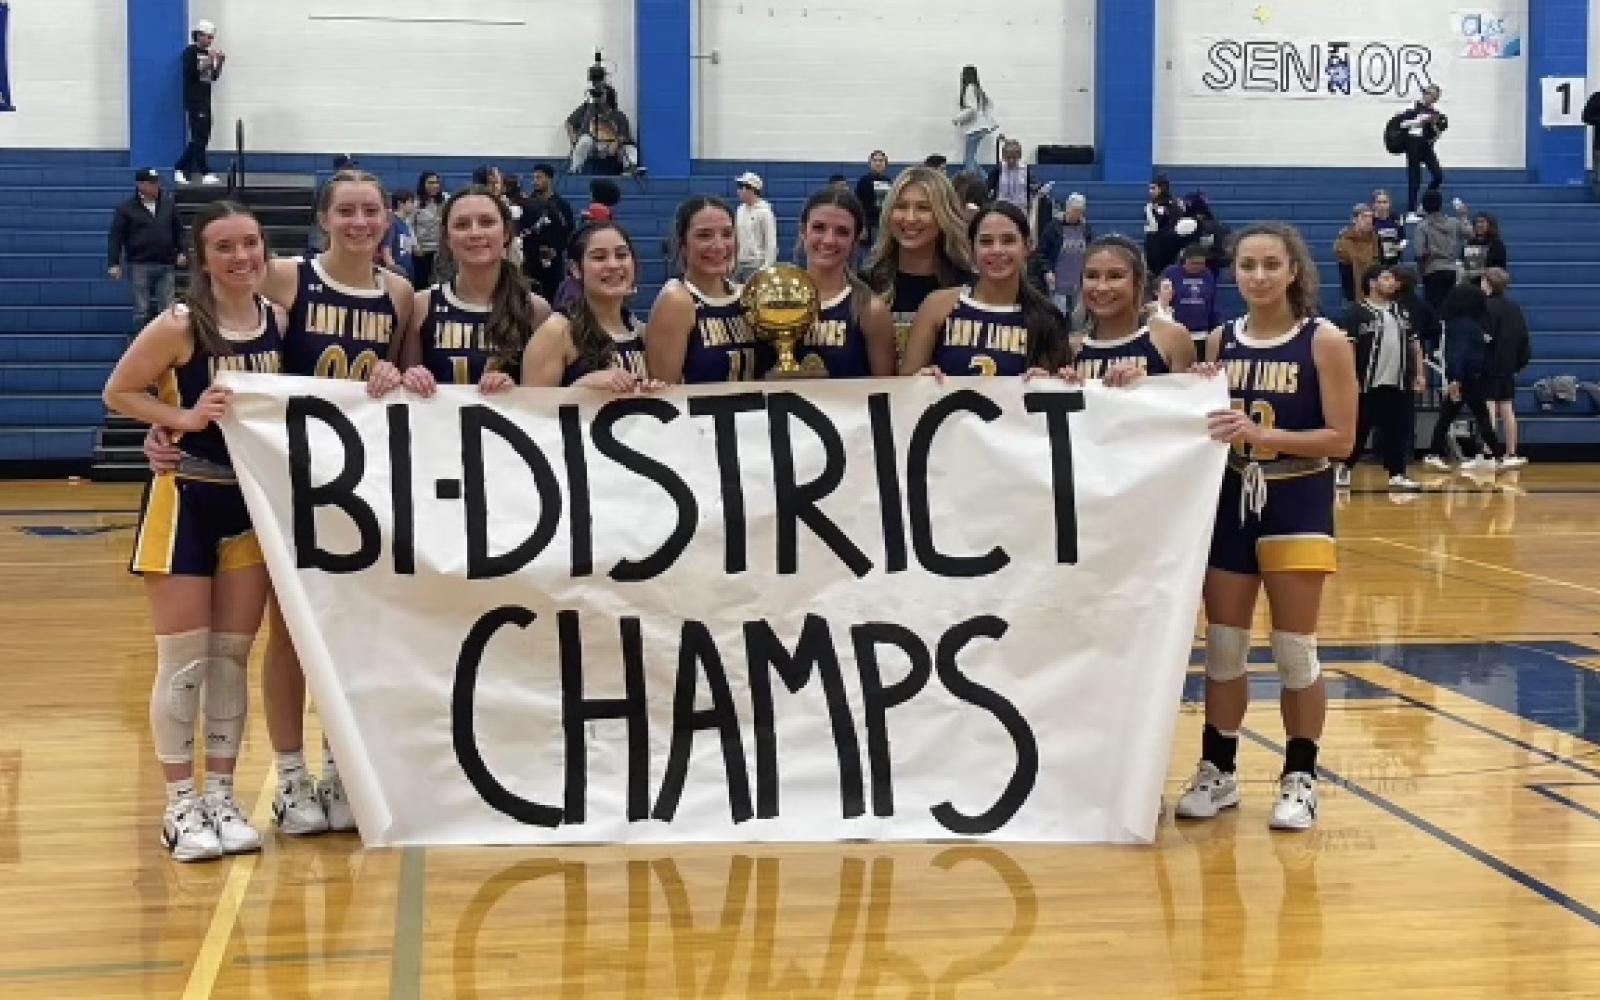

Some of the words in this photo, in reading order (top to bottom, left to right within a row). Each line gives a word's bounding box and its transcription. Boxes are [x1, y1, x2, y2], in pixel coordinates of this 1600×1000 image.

[1202, 40, 1434, 97] SENIOR
[1556, 83, 1571, 115] 1
[286, 390, 1085, 582] BI-DISTRICT
[453, 605, 1038, 833] CHAMPS
